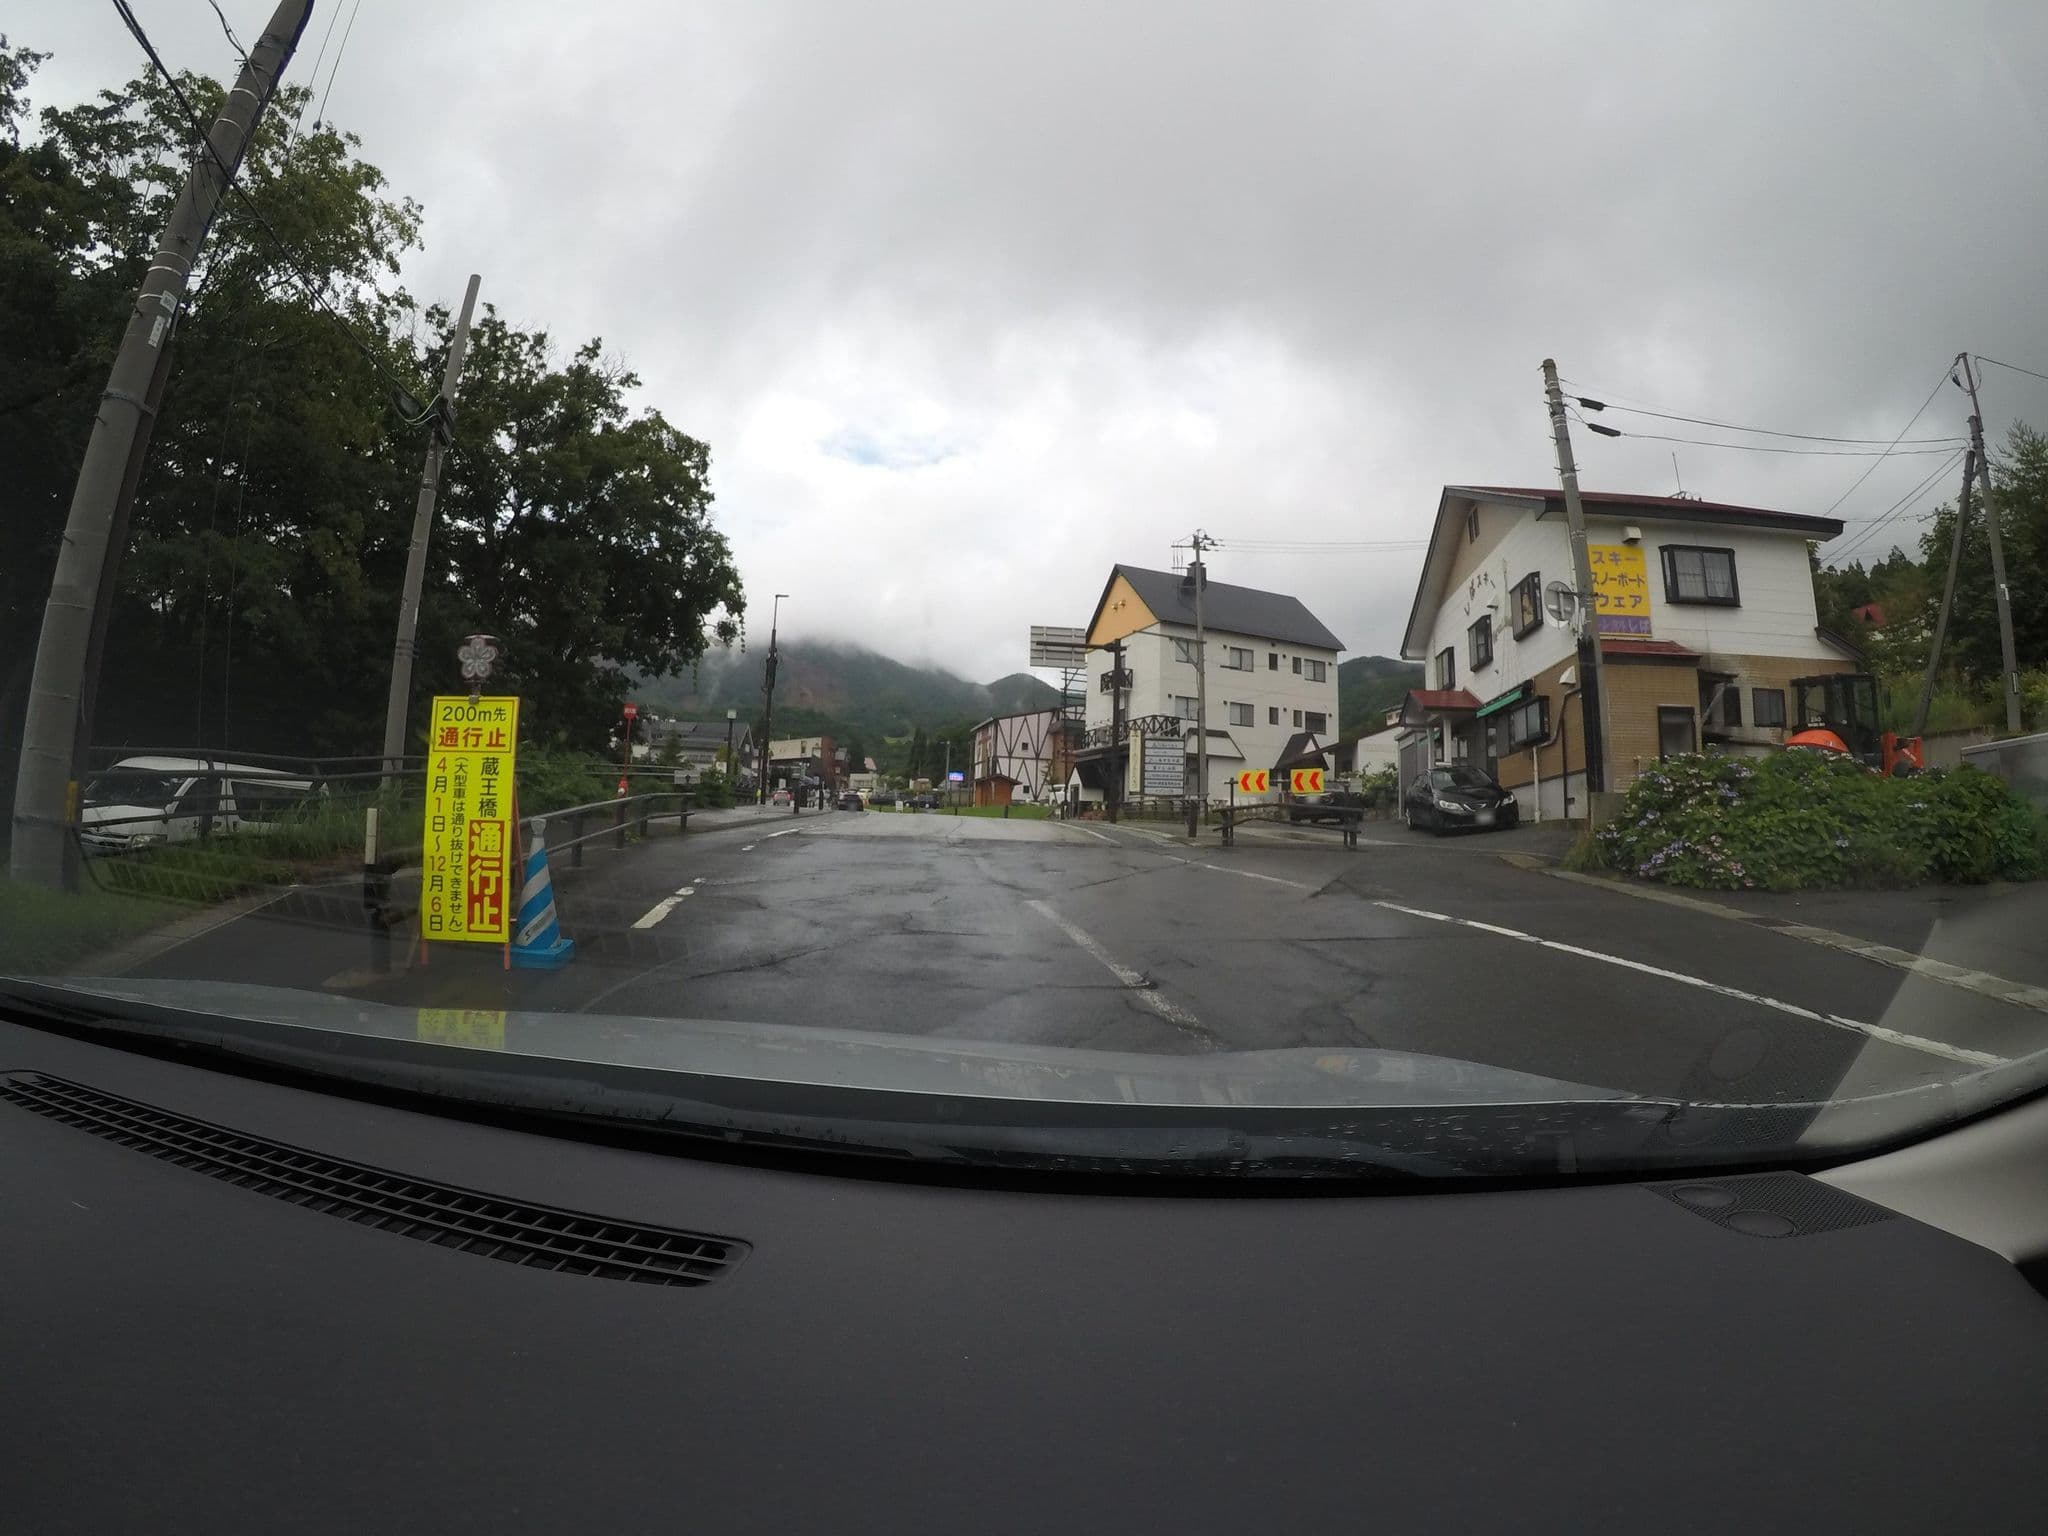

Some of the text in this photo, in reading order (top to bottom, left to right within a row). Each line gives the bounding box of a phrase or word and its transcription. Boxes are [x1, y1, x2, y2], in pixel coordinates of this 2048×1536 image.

[1592, 551, 1638, 566] スキー
[442, 706, 506, 722] 200m先
[438, 727, 506, 747] 通行止
[478, 757, 500, 818] 蔵王橋
[470, 822, 501, 931] 通行止
